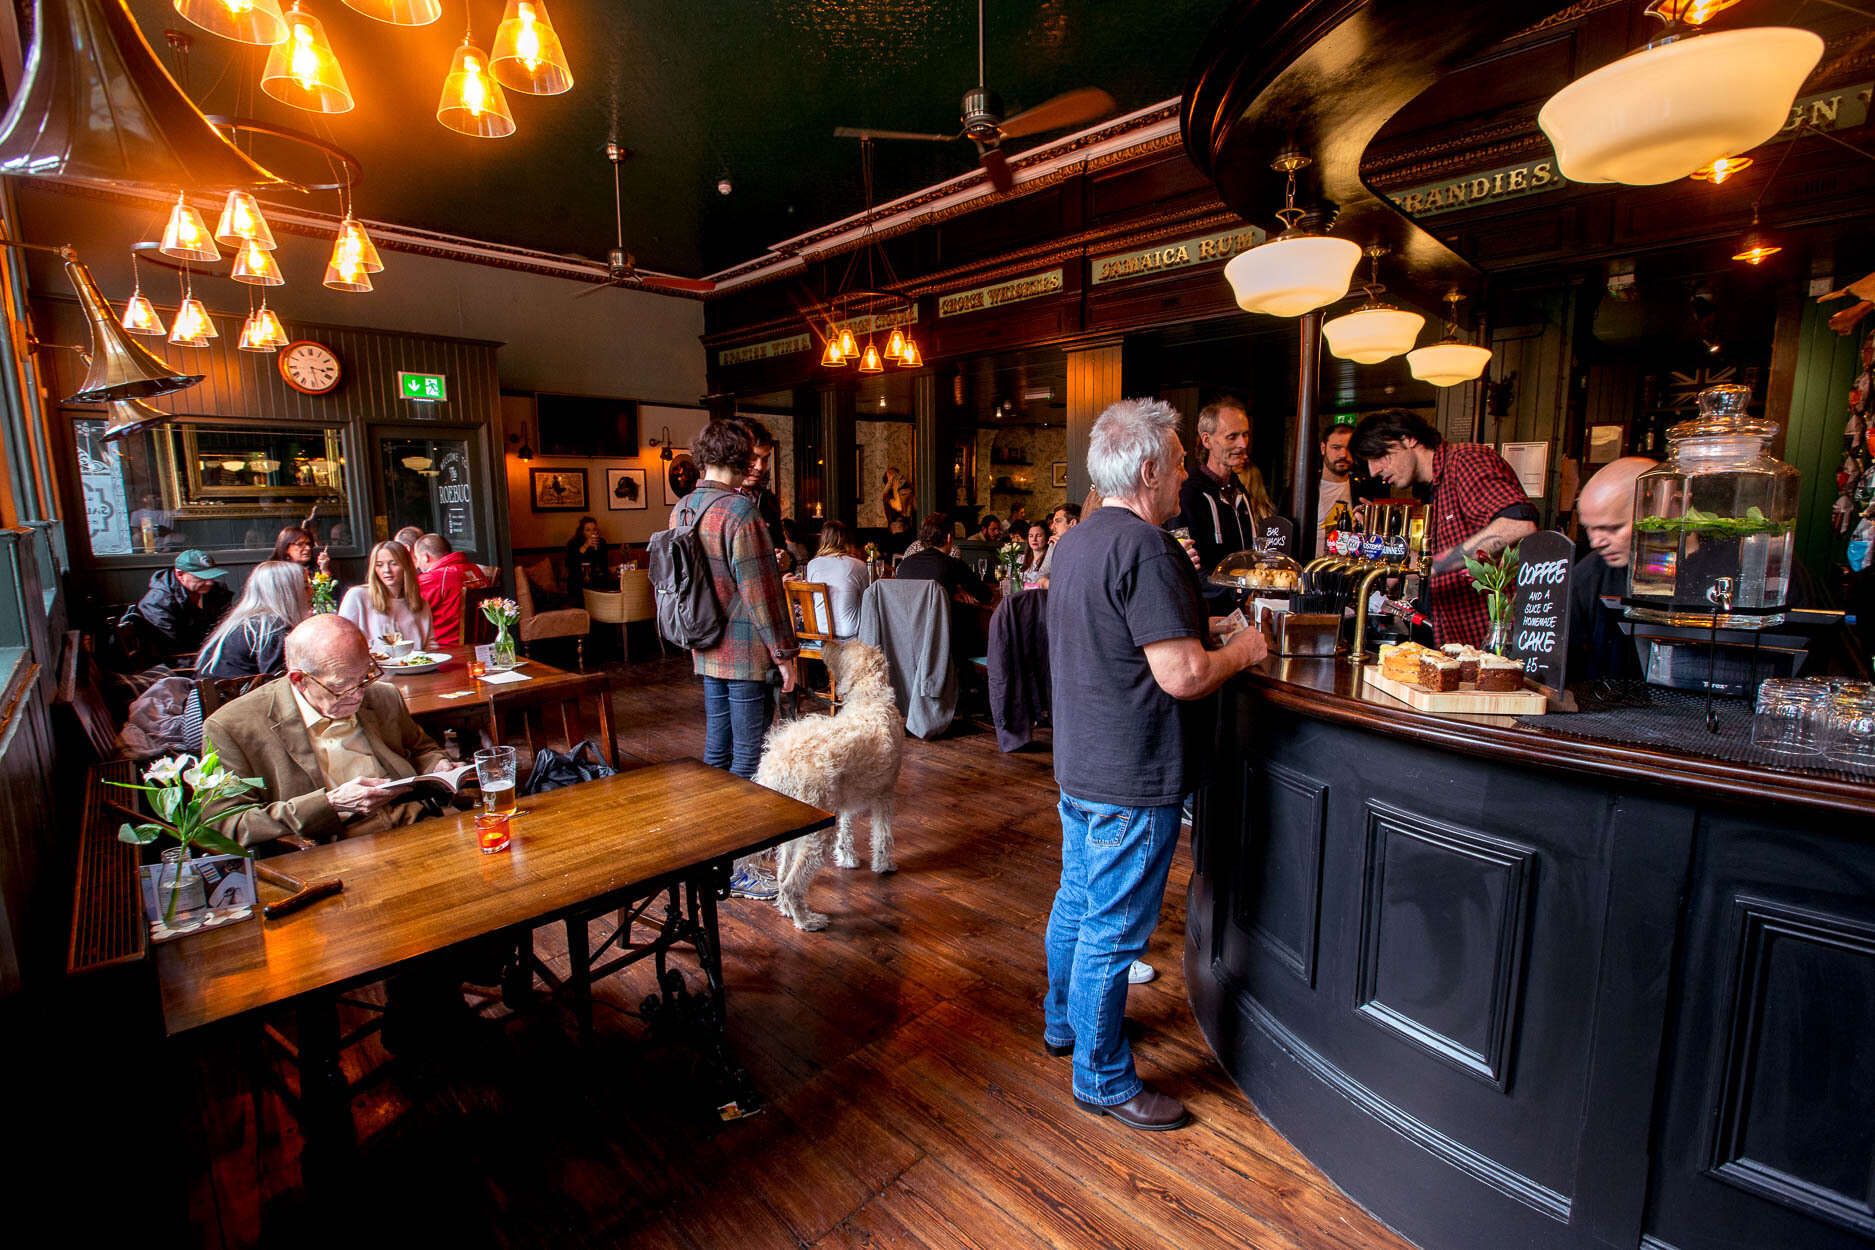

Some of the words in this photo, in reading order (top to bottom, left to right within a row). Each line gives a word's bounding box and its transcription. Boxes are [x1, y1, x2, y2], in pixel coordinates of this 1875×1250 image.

[1099, 245, 1190, 281] JAMAICA
[1198, 231, 1255, 261] RUM
[1266, 527, 1280, 537] BAR
[1518, 559, 1568, 587] COFFEE
[1528, 591, 1542, 601] AND
[1544, 589, 1551, 600] A
[1524, 603, 1541, 614] SLICE
[1542, 602, 1554, 613] OF
[1522, 616, 1558, 628] HOMEMADE
[1518, 630, 1556, 653] CAKE
